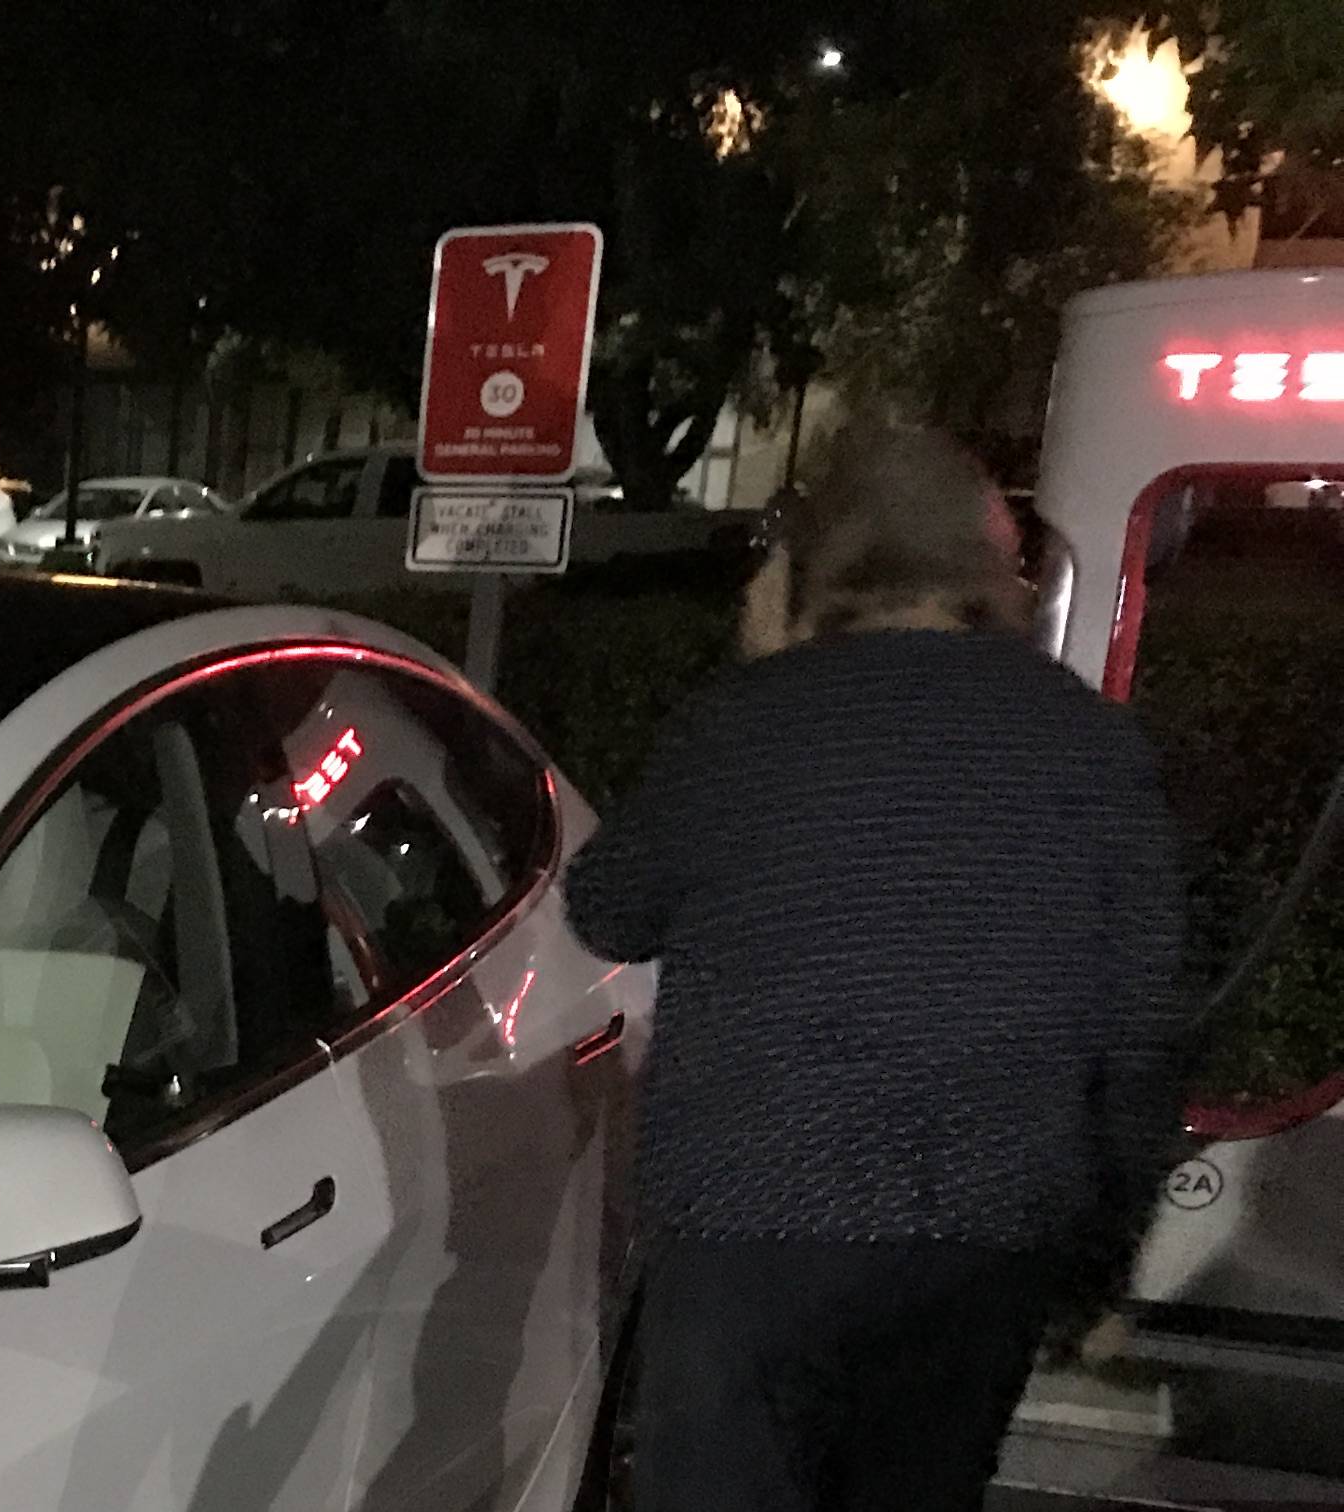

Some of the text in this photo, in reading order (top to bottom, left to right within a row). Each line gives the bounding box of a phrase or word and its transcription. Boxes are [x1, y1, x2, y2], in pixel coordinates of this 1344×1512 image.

[469, 343, 545, 358] TESLA
[486, 383, 517, 403] 30
[1174, 1172, 1213, 1194] 2A
